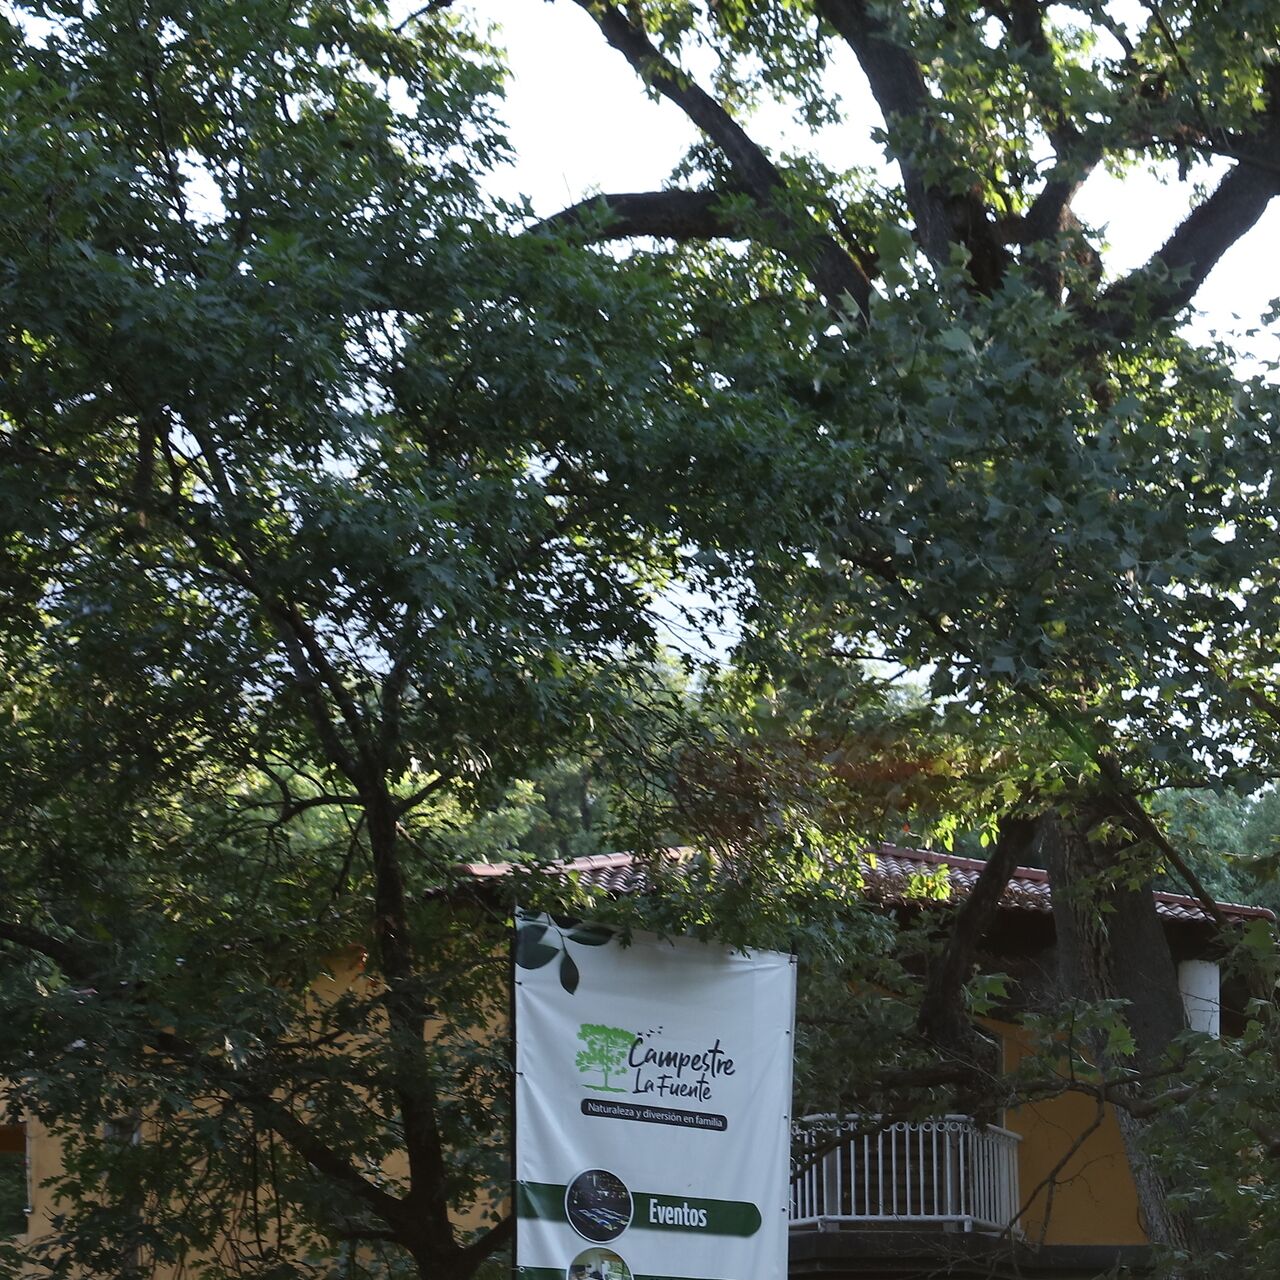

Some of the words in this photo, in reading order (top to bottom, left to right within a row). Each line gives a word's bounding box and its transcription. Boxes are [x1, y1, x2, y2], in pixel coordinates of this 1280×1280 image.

[628, 1037, 735, 1078] Campestre
[632, 1068, 654, 1094] La
[657, 1073, 712, 1102] Fuente
[588, 1102, 635, 1117] Naturaleza
[635, 1109, 641, 1119] y
[643, 1108, 682, 1122] diversión
[683, 1116, 694, 1124] en
[695, 1115, 723, 1128] familia
[649, 1198, 707, 1227] Eventos
